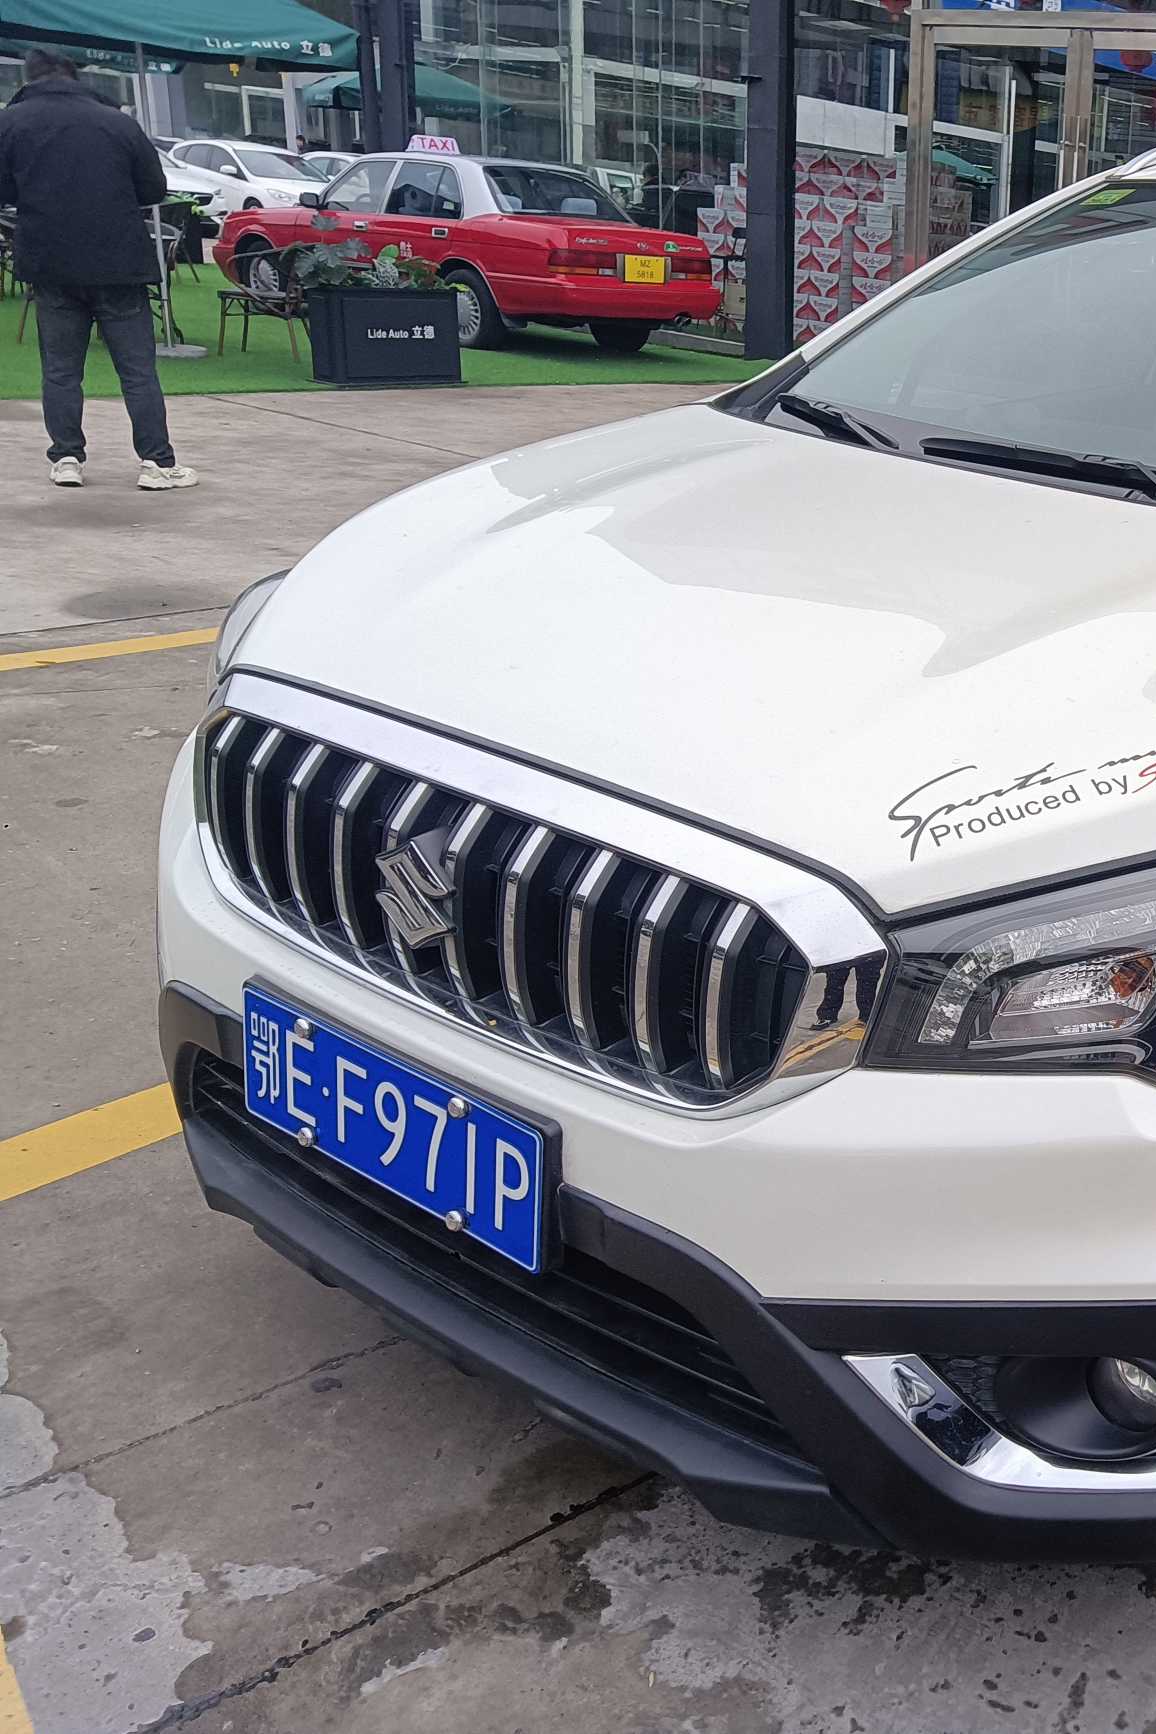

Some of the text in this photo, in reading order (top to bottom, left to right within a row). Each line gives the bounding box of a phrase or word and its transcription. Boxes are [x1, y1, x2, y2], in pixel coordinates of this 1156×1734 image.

[416, 136, 456, 151] TAXI
[367, 325, 435, 339] Lide Auto 立德
[928, 784, 1081, 848] Produced
[1094, 774, 1130, 796] by
